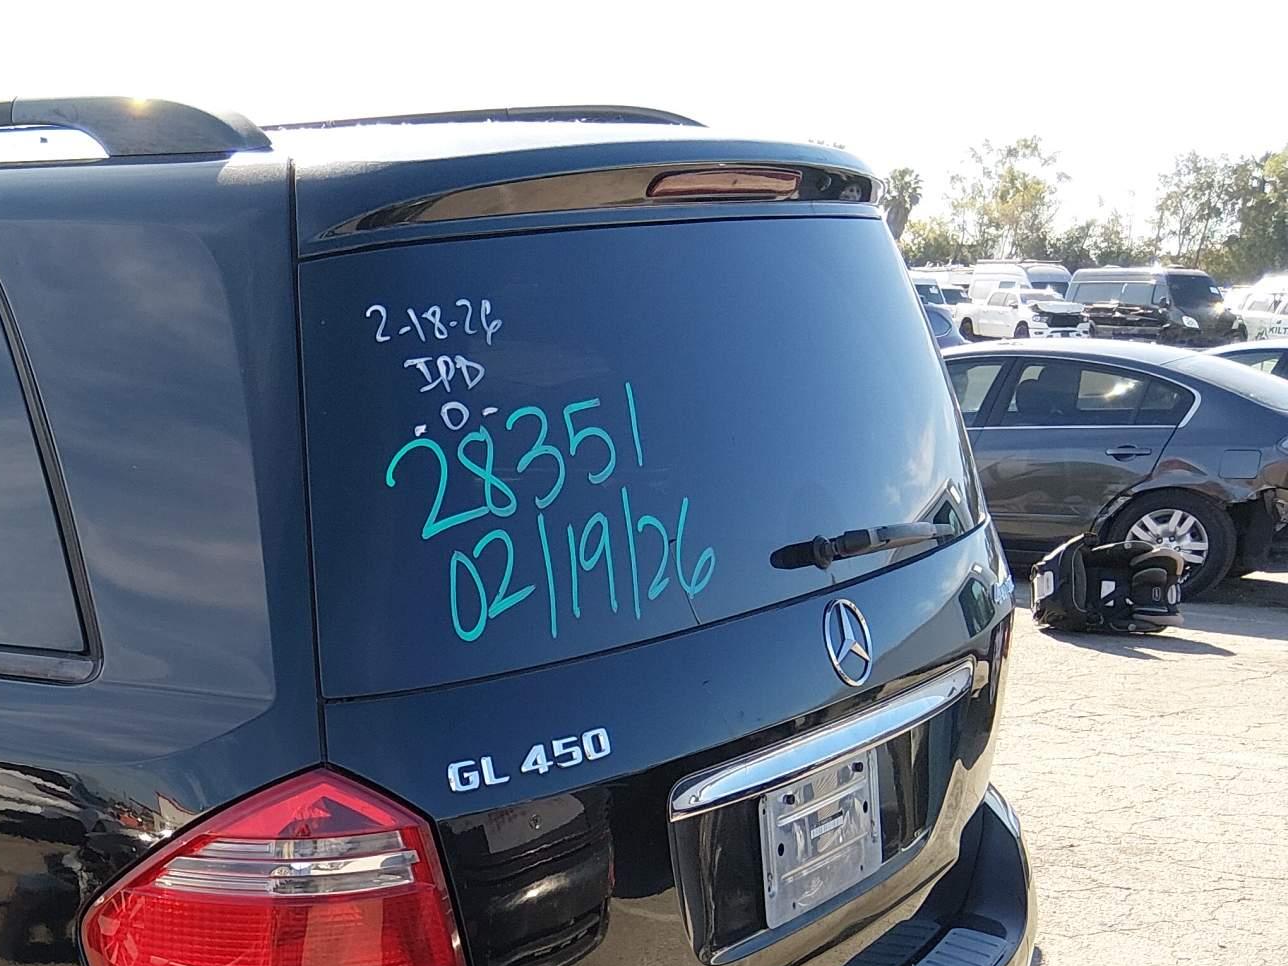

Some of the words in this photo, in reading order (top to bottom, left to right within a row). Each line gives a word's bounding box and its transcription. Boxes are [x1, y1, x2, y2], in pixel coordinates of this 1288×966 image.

[365, 298, 503, 345] 2-18-26
[385, 381, 644, 540] 28351
[449, 486, 716, 642] 02/19/26
[447, 755, 510, 792] GL
[520, 726, 612, 774] 450
